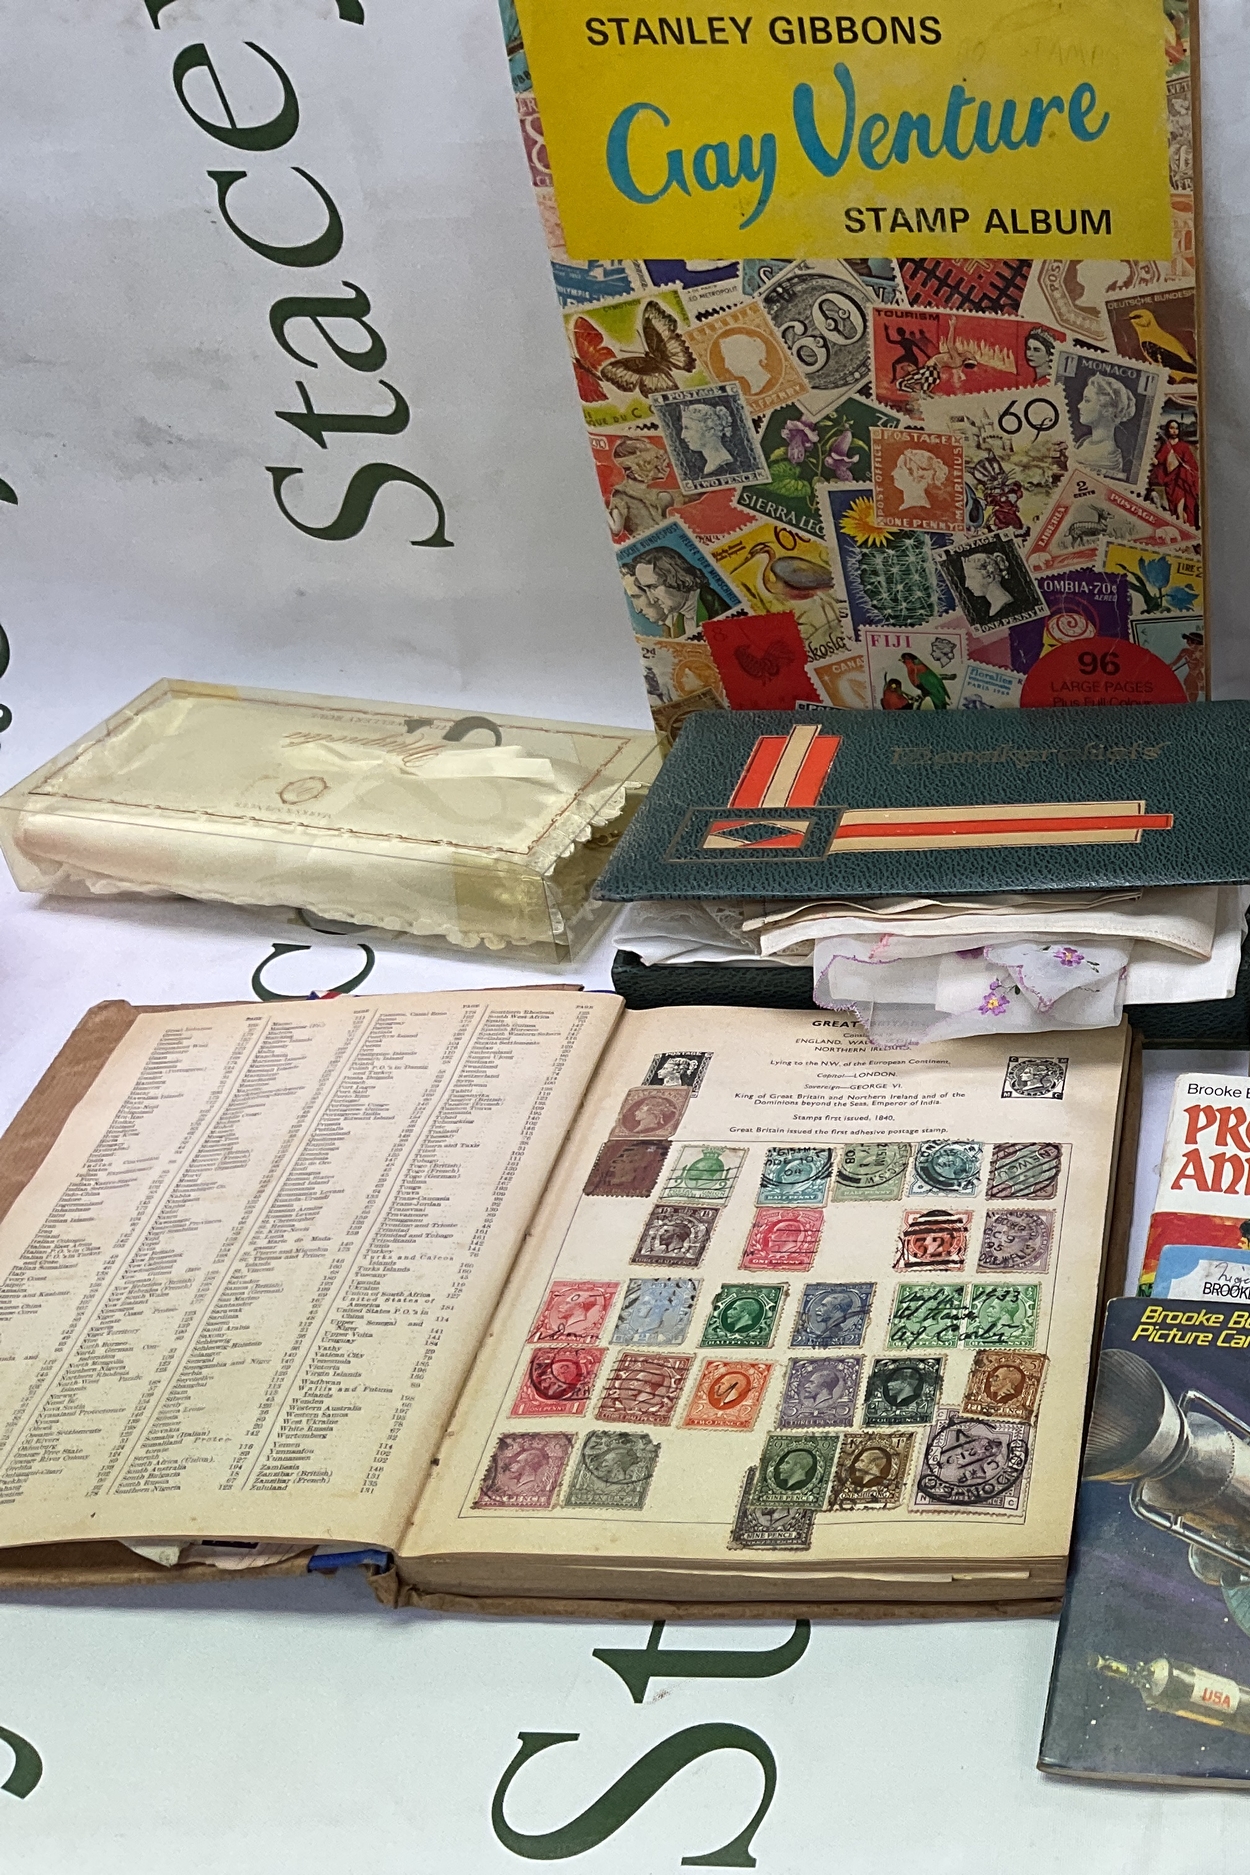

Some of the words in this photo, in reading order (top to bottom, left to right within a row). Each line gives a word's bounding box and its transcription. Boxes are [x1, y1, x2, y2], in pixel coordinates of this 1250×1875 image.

[585, 16, 753, 46] STANLEY
[768, 16, 943, 46] GIBBONS
[606, 102, 777, 230] Gay
[792, 62, 1110, 178] Venture
[843, 207, 970, 235] STAMP
[983, 208, 1113, 236] ALBUM
[145, 0, 454, 547] Stace
[1108, 294, 1151, 309] DEUTSCHE
[875, 309, 940, 321] TOURISM
[1081, 360, 1138, 379] MONACO
[667, 386, 721, 400] POSTAGE
[694, 478, 719, 490] TWO
[719, 473, 758, 487] PENCE
[1076, 480, 1087, 492] 2
[741, 491, 797, 525] SIERRA
[1109, 493, 1158, 524] POSTAGE
[886, 517, 909, 528] ONE
[911, 519, 955, 531] PENNY
[1038, 505, 1068, 547] LIBERIA
[950, 534, 997, 555] POSTAGE
[982, 618, 1004, 634] ONE
[1004, 610, 1036, 628] PENNY
[871, 634, 912, 648] FIJI
[1077, 651, 1121, 676] 96
[1050, 680, 1101, 693] LARGE
[1104, 681, 1153, 693] PAGES
[812, 1020, 860, 1028] GREAT
[770, 1059, 792, 1067] Lying
[868, 1058, 906, 1067] European
[734, 1092, 754, 1101] King
[797, 1092, 825, 1100] Britain
[890, 1092, 919, 1100] Ireland
[1187, 1083, 1242, 1098] Brooke
[753, 1098, 798, 1106] Dominions
[801, 1099, 831, 1108] beyond
[871, 1100, 907, 1108] Emperor
[792, 1114, 822, 1123] Stamps
[824, 1114, 843, 1122] first
[830, 1126, 849, 1134] first
[850, 1126, 886, 1134] adhesive
[887, 1127, 919, 1136] postage
[1141, 1305, 1225, 1328] Brooke
[1131, 1326, 1213, 1346] Picture
[1201, 1687, 1232, 1708] USA
